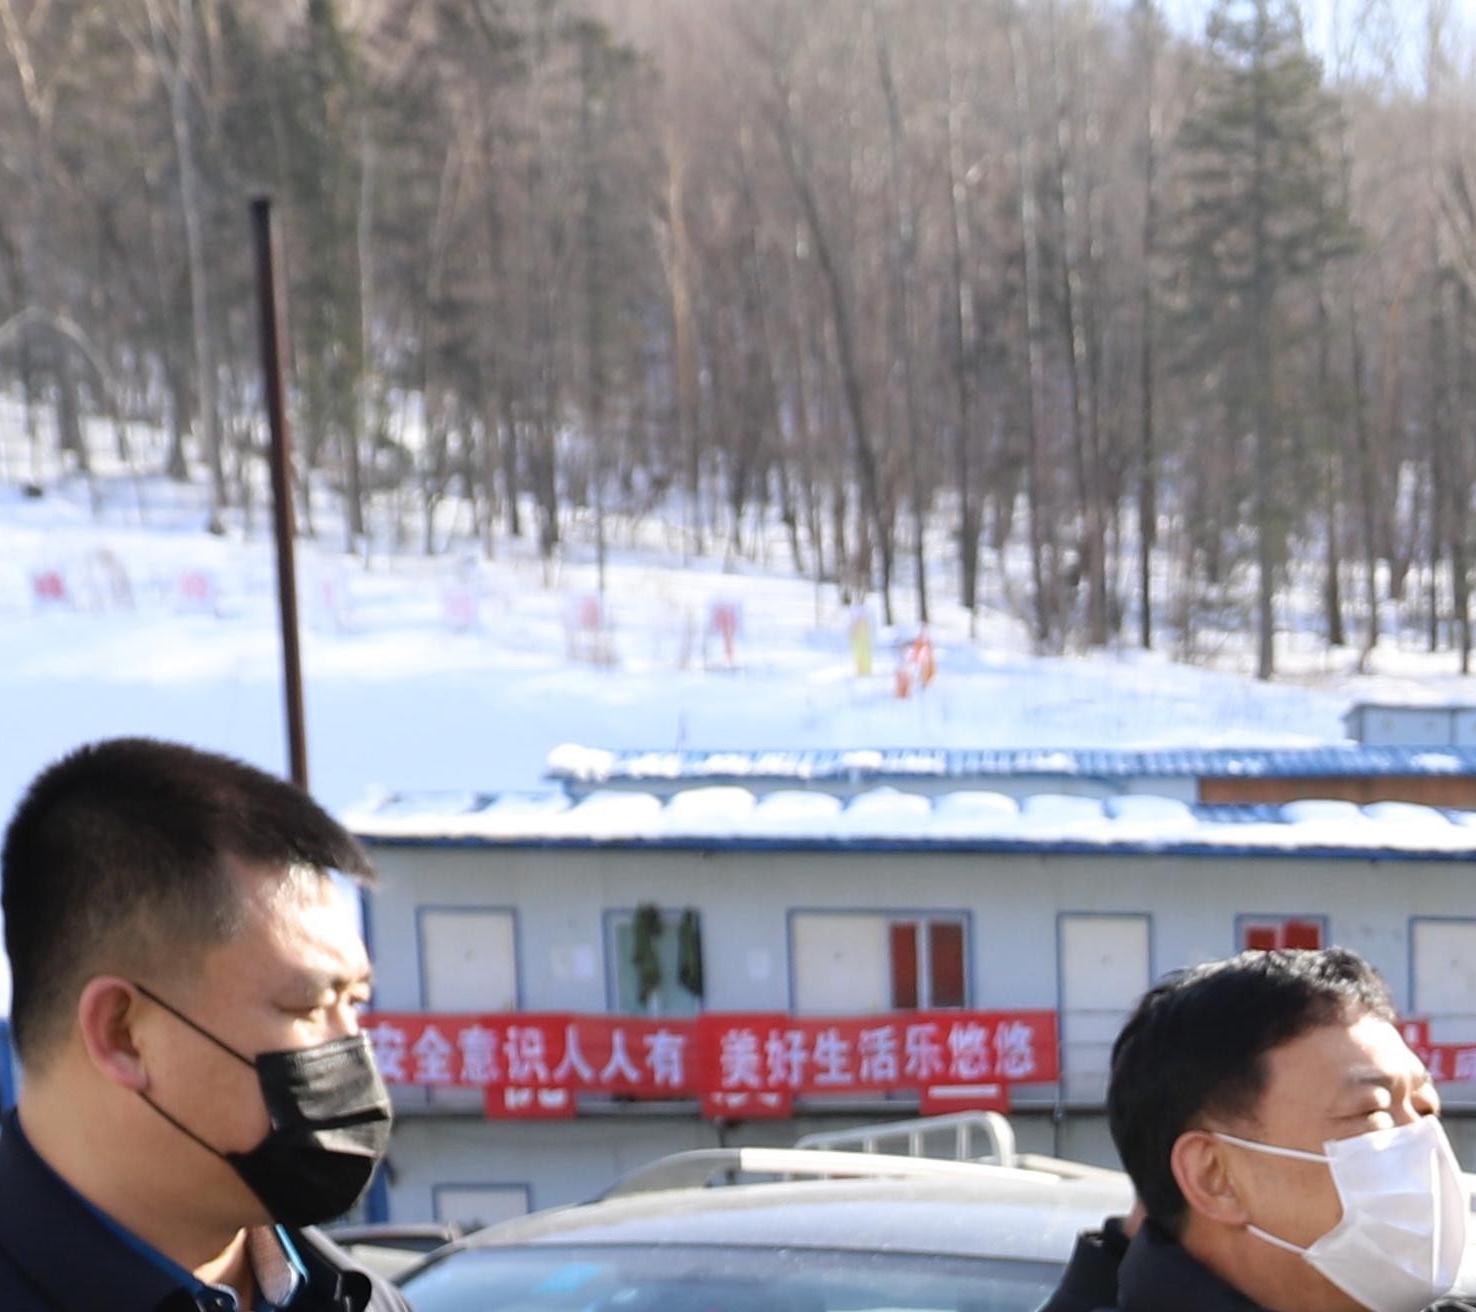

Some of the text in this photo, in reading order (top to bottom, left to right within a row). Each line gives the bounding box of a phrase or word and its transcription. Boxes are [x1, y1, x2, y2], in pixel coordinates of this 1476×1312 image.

[720, 1020, 1036, 1087] 美好生活乐悠悠
